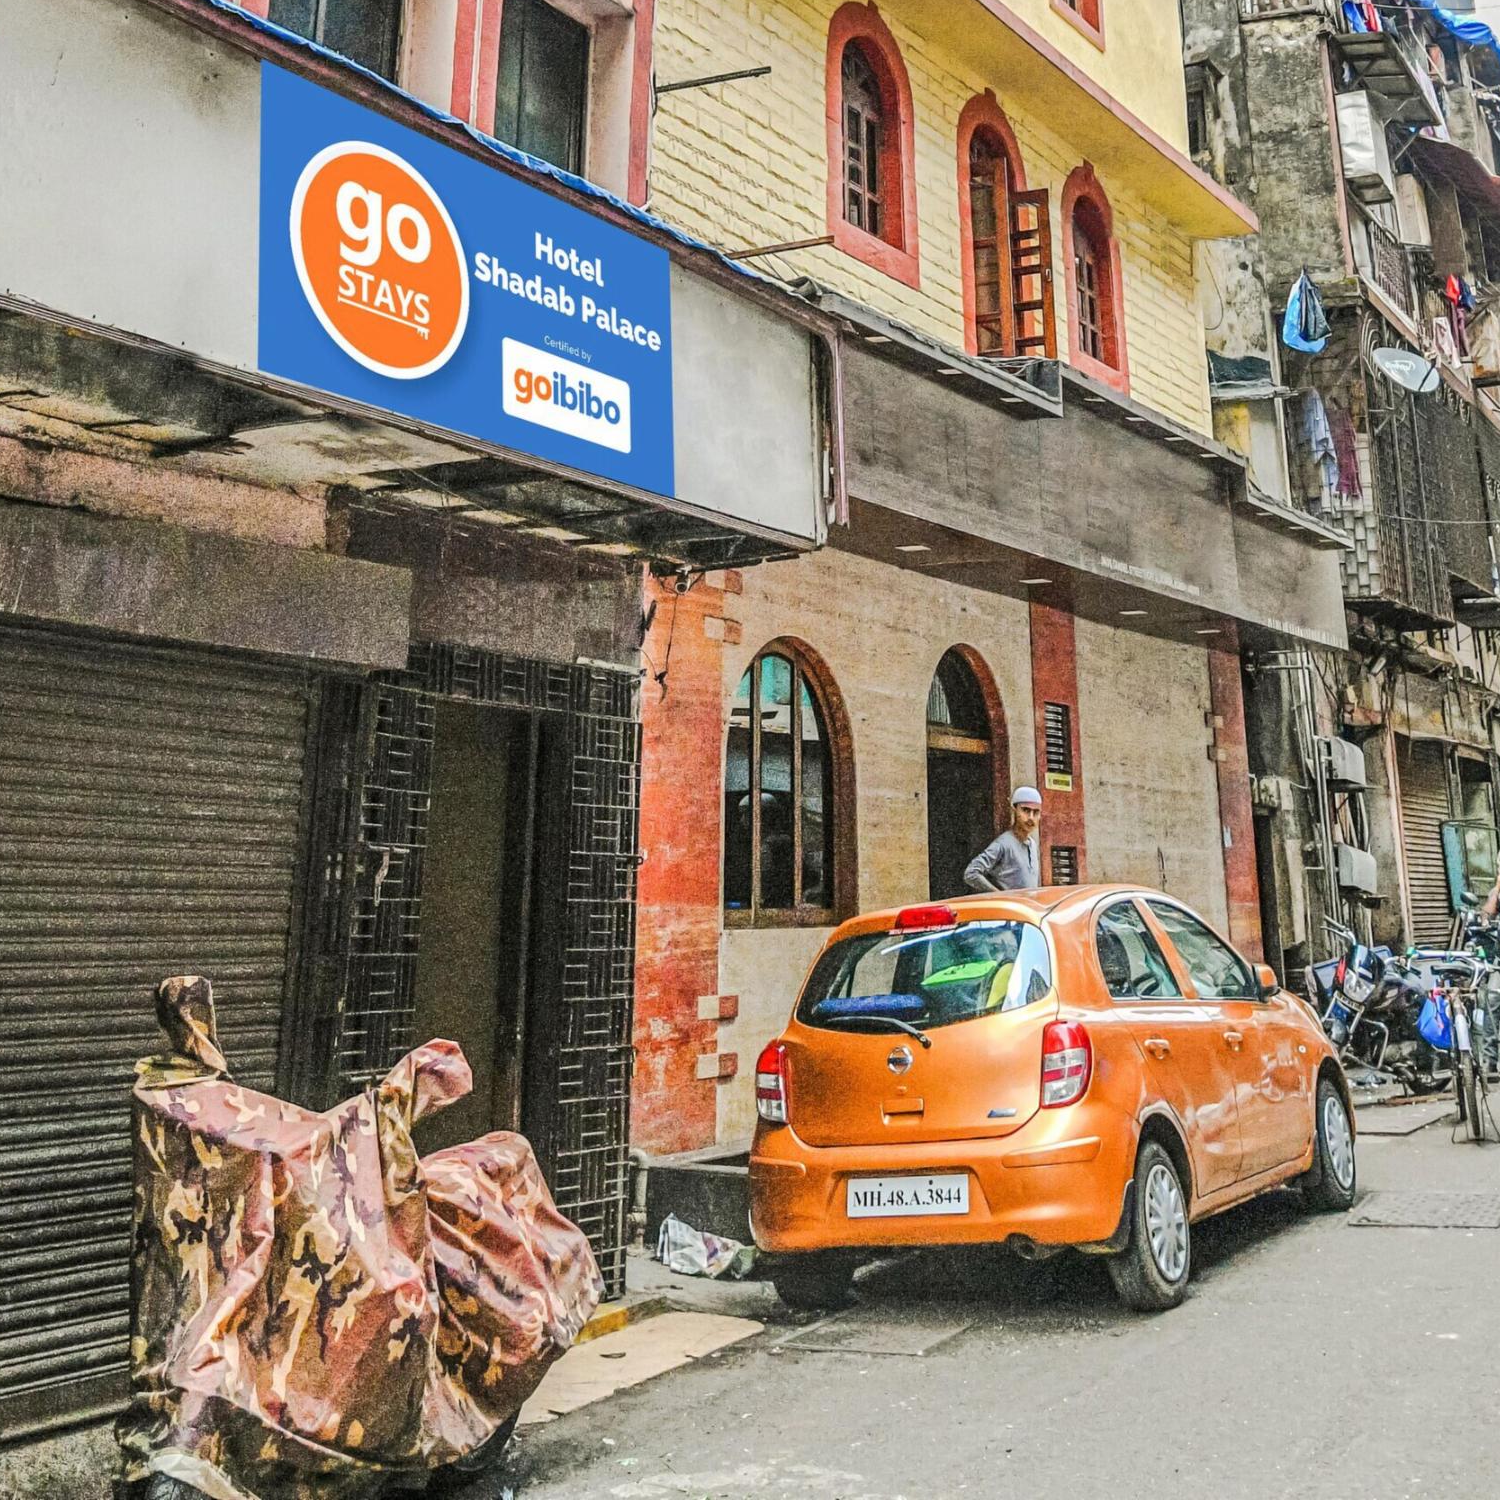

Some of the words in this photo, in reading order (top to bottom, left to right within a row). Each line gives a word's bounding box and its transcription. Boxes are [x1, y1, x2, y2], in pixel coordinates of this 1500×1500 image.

[336, 181, 431, 267] go
[535, 232, 604, 287] Hotel
[338, 264, 431, 325] STAYS
[474, 252, 576, 317] Shadab
[581, 295, 662, 352] Palace
[543, 335, 580, 357] Certified
[581, 348, 593, 364] by
[513, 367, 621, 425] goibibo
[853, 1187, 962, 1207] MH.48.A.3844
